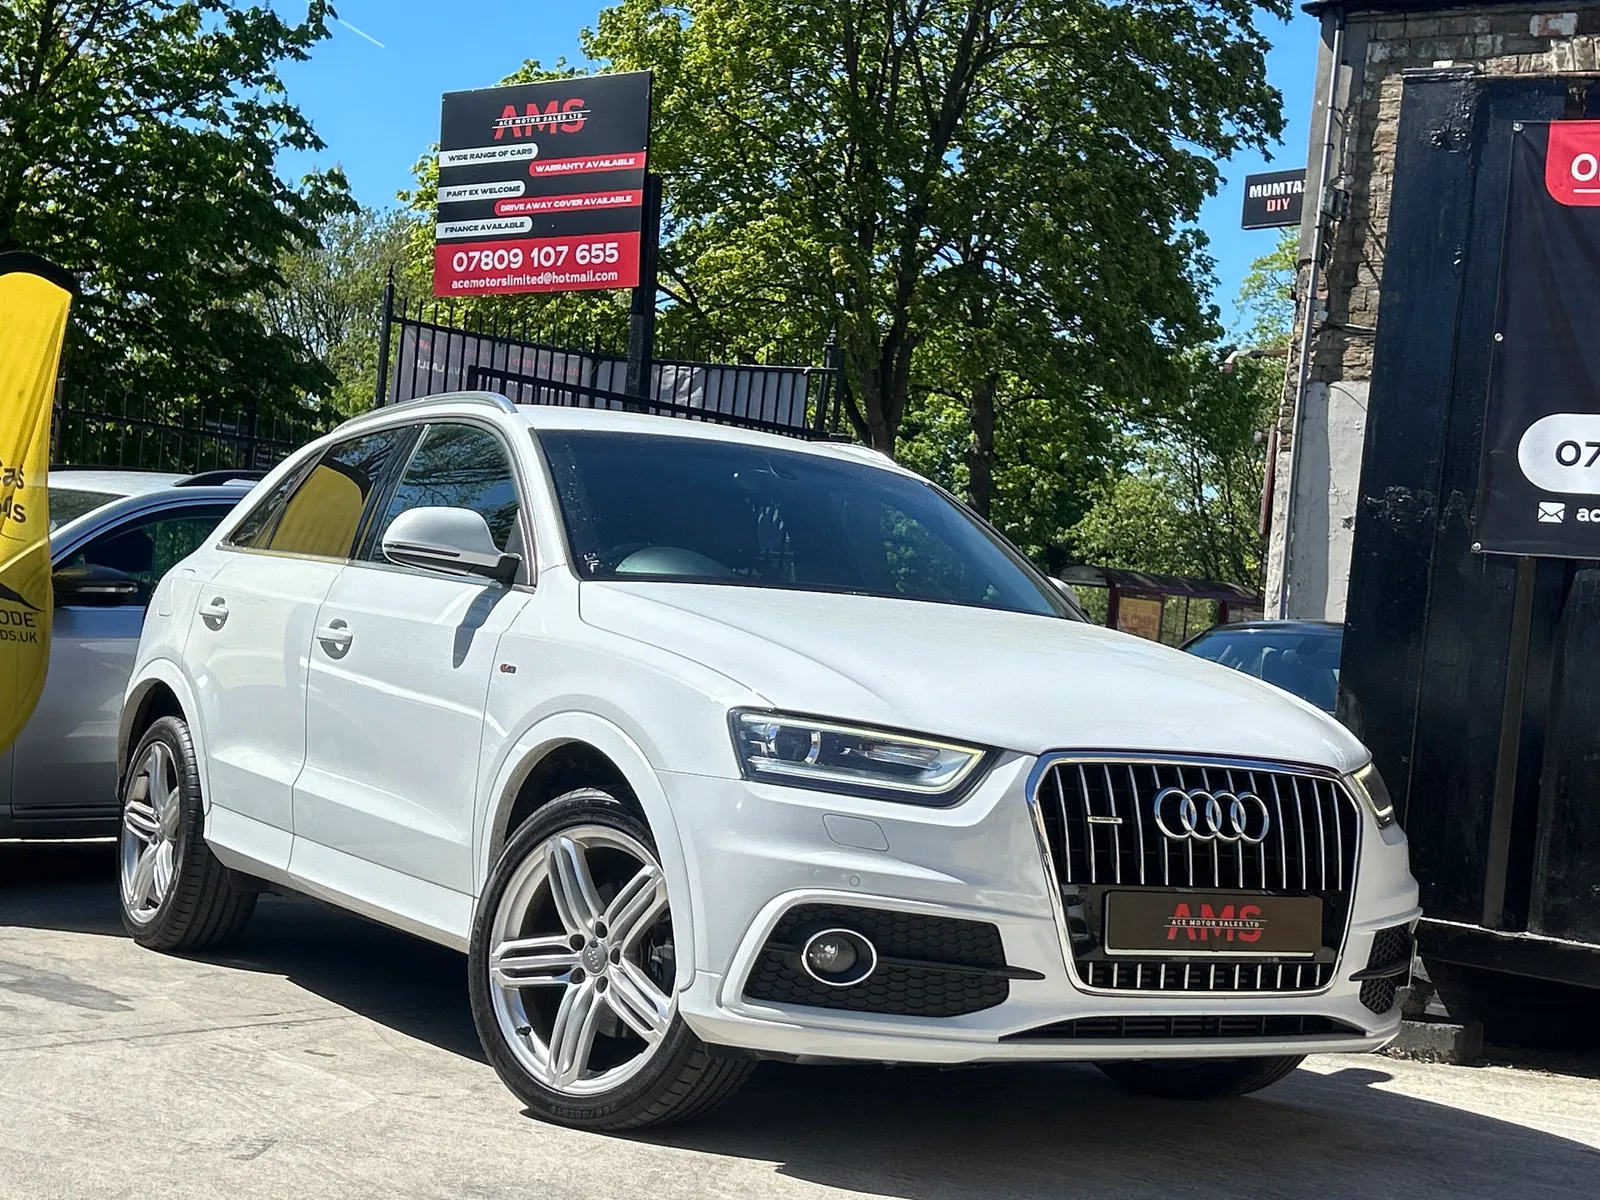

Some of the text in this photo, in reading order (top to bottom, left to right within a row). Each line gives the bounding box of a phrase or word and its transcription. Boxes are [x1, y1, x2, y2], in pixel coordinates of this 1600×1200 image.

[493, 98, 585, 140] AMS
[515, 116, 540, 125] MOTOR
[543, 114, 567, 122] SALES
[569, 112, 583, 120] LTD
[448, 148, 533, 162] WIDE RANGE OF CARS
[535, 158, 635, 173] WARRANTY AVAILABLE
[1571, 153, 1600, 182] O
[446, 185, 521, 197] PART EX WELCOME
[500, 195, 632, 212] DRIVE AWAY COVER AVAILABLE
[1266, 197, 1290, 212] DIY
[445, 221, 525, 234] FINANCE AVAILABLE
[452, 242, 619, 272] 07809 107 655
[451, 269, 618, 289] acemotorslimited@hotmail.com
[1166, 903, 1262, 943] AMS
[1189, 919, 1216, 927] MOTOR
